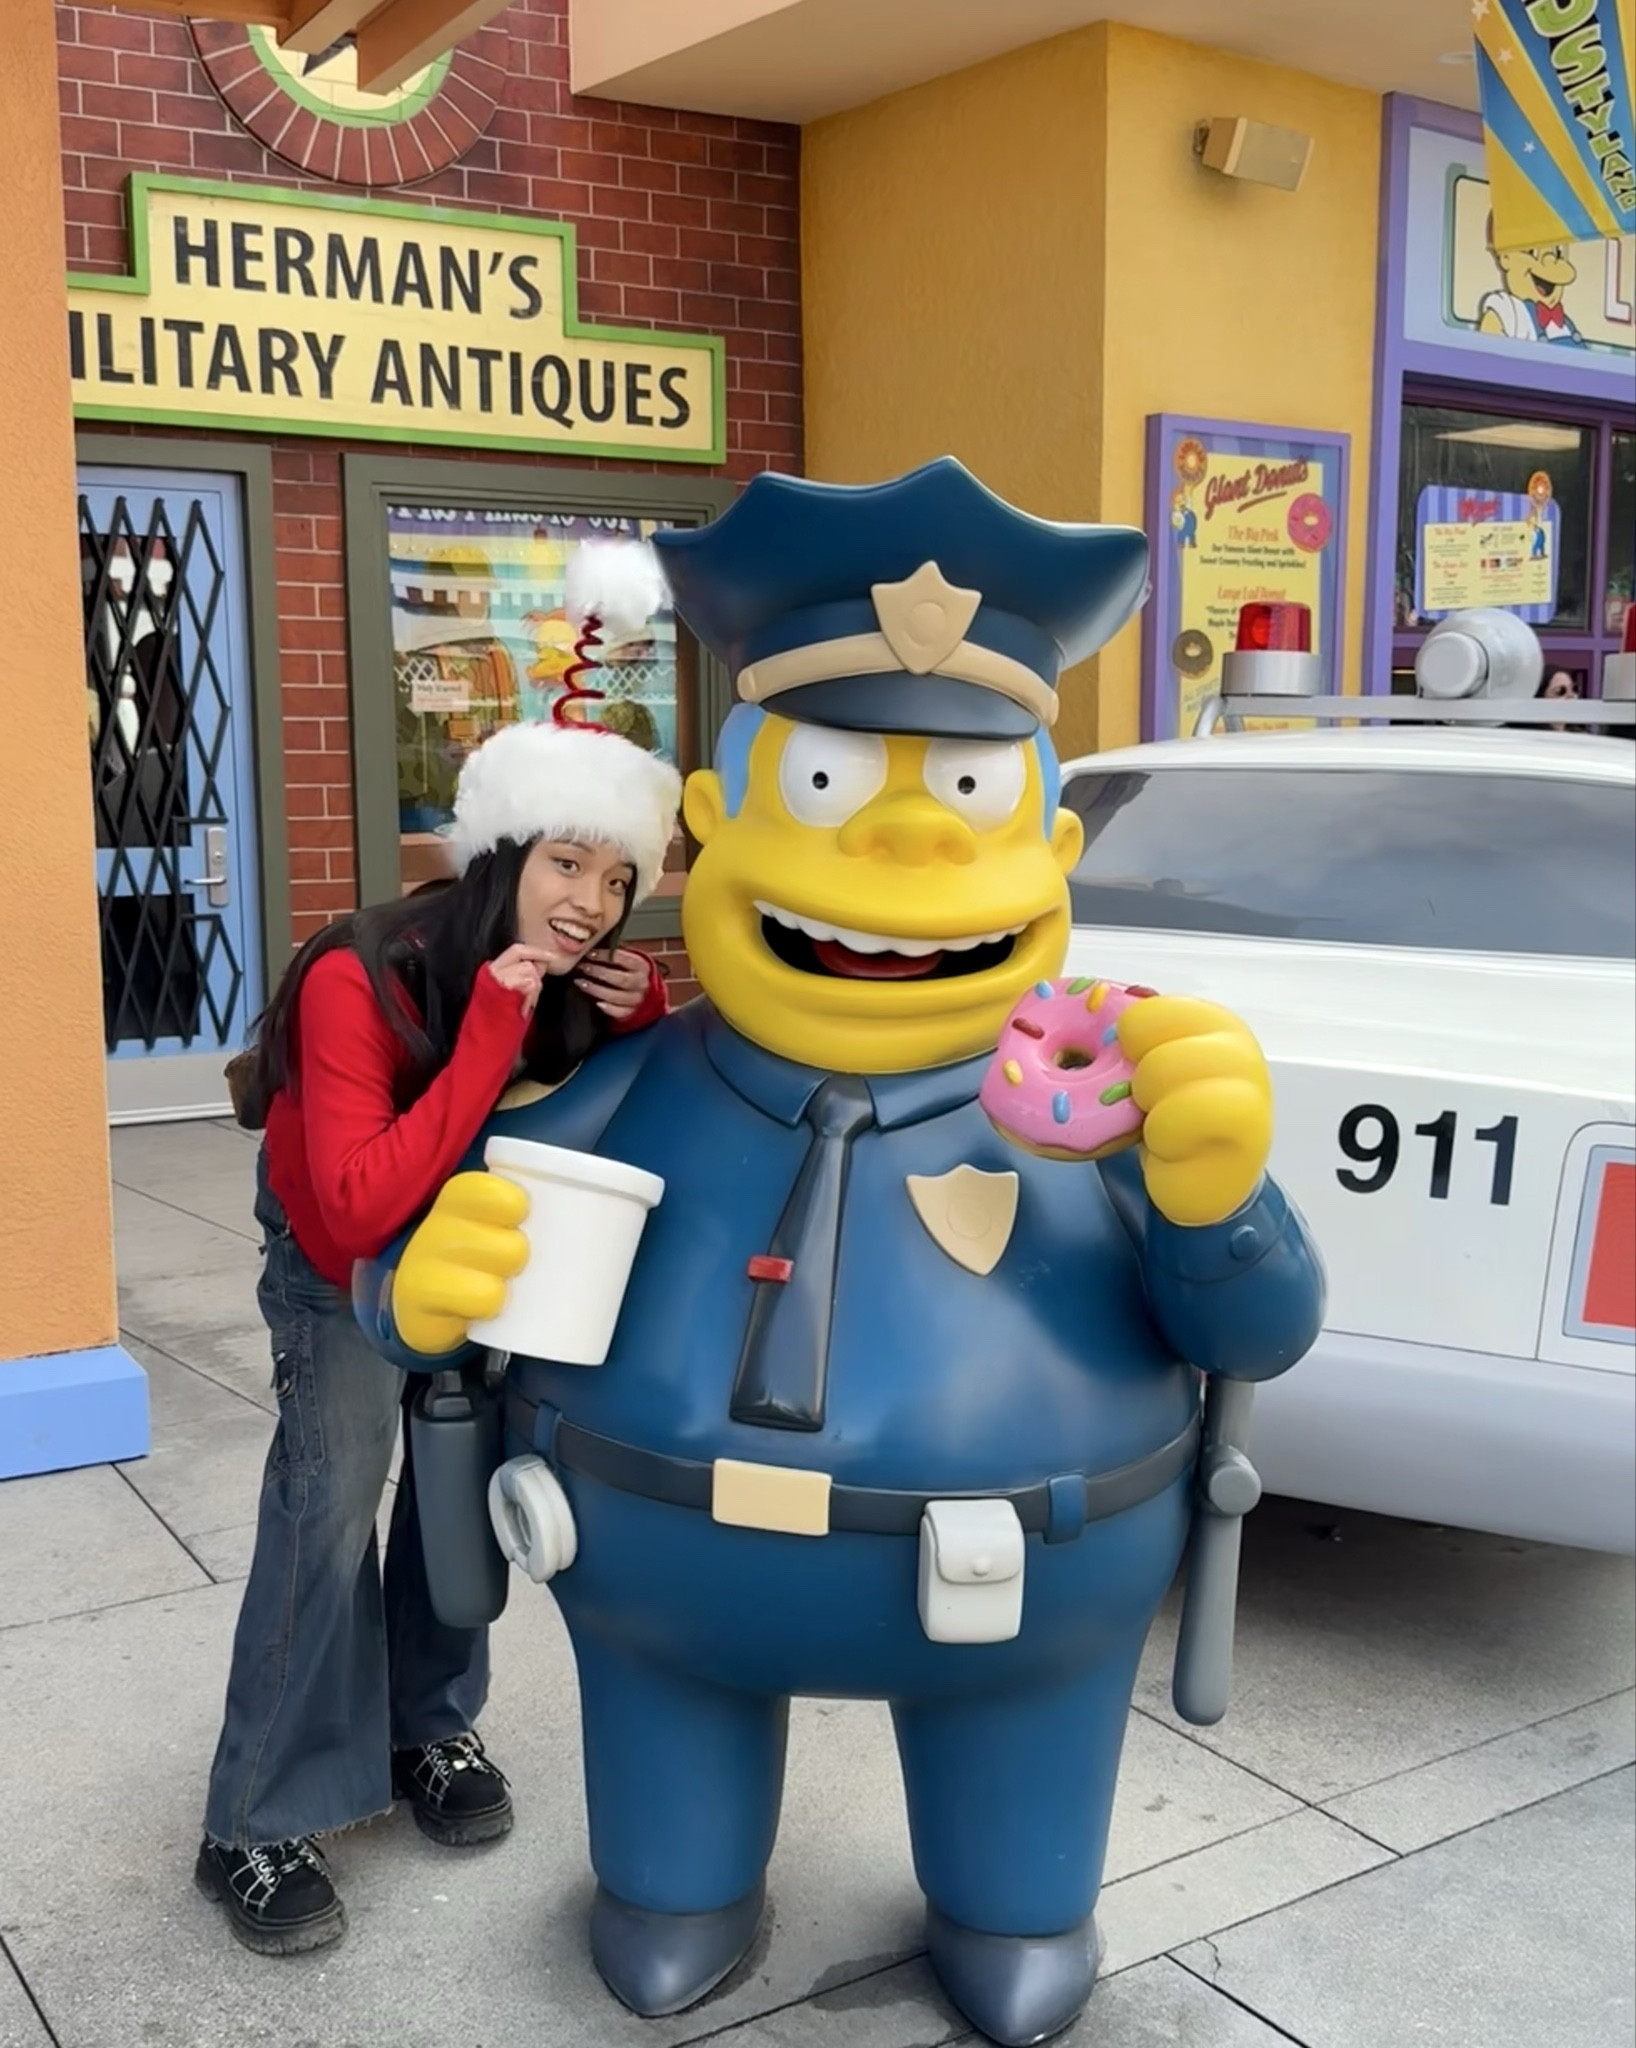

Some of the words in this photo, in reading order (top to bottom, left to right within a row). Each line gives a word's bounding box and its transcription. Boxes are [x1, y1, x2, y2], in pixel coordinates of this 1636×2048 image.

[173, 215, 543, 320] HERMAN'S
[371, 339, 691, 430] ANTIQUES
[1204, 469, 1251, 520] Giant
[1228, 525, 1244, 539] The
[1261, 528, 1279, 541] Pink
[1336, 1103, 1519, 1206] 911
